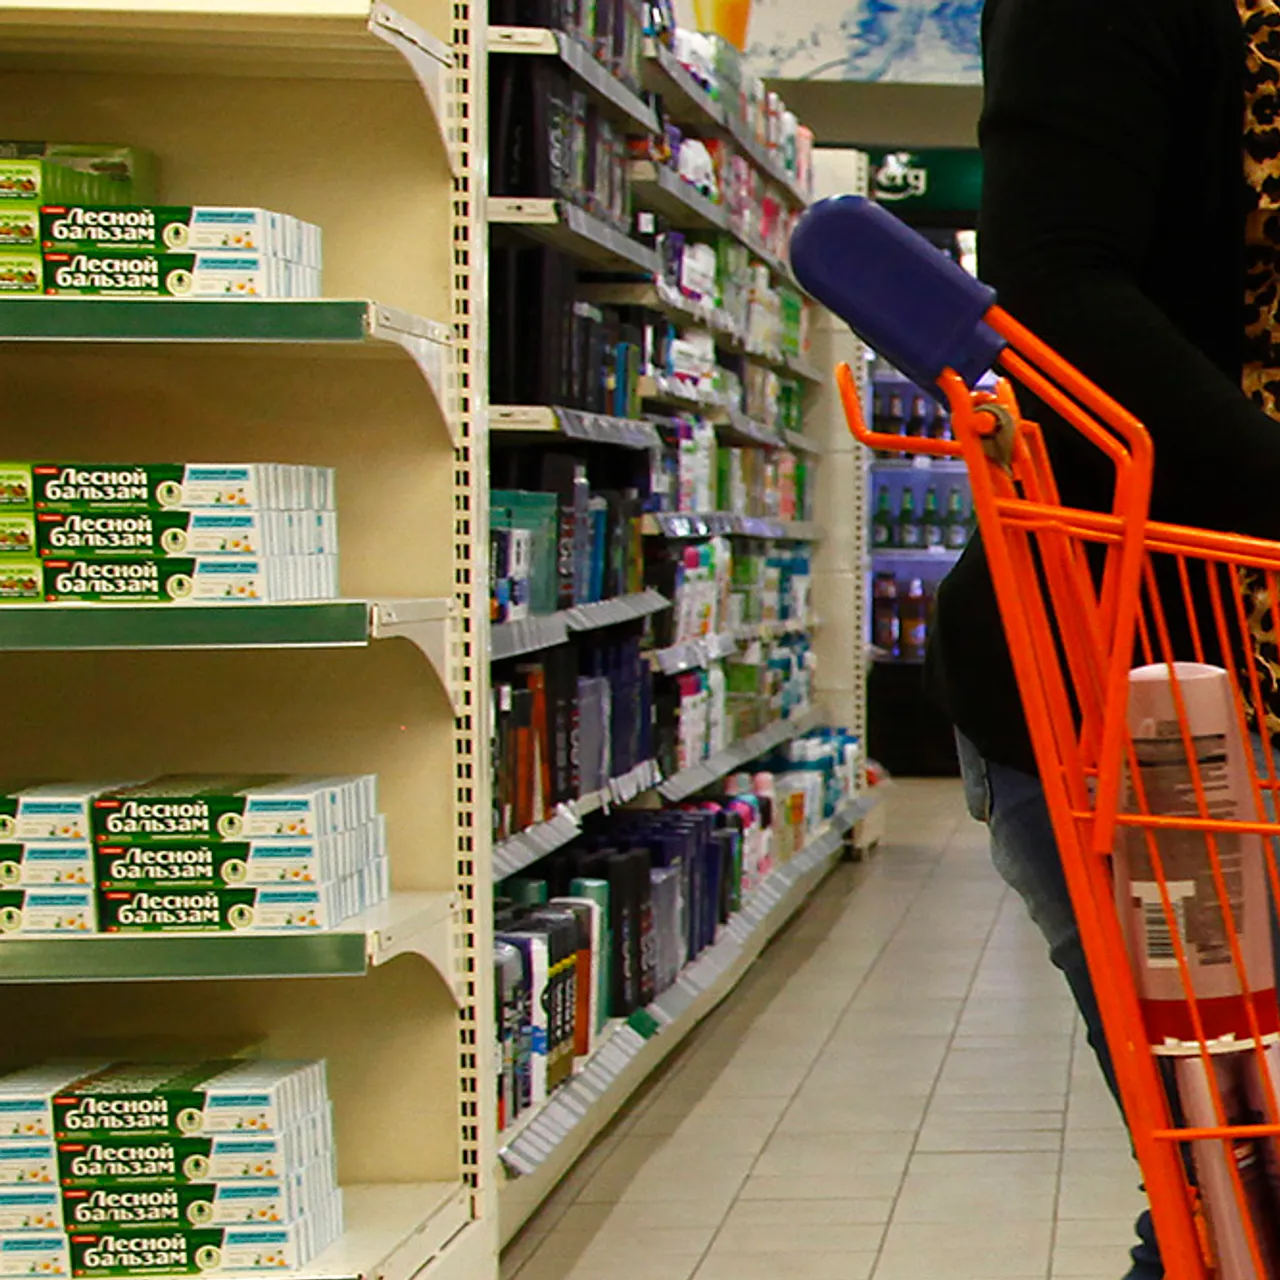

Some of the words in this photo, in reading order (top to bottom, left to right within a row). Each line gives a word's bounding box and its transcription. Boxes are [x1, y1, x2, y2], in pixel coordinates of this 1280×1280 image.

[67, 208, 155, 226] Лесной
[52, 219, 155, 241] бальзам
[70, 255, 159, 273] Лесной
[55, 266, 159, 288] бальзам
[59, 468, 148, 485] Лесной
[45, 480, 149, 500] бальзам
[63, 515, 153, 532] Лесной
[50, 527, 154, 547] бальзам
[70, 561, 158, 578] Лесной
[56, 573, 159, 593] бальзам
[121, 801, 209, 818] Лесной
[107, 814, 209, 832] бальзам
[125, 847, 213, 864] Лесной
[111, 860, 213, 879] бальзам
[131, 892, 219, 909] Лесной
[118, 905, 220, 924] бальзам
[78, 1097, 168, 1114] Лесной
[65, 1109, 168, 1129] бальзам
[85, 1144, 174, 1160] Лесной
[71, 1156, 175, 1175] бальзам
[89, 1189, 178, 1206] Лесной
[75, 1202, 179, 1222] бальзам
[97, 1234, 187, 1252] Лесной
[83, 1247, 188, 1267] бальзам
